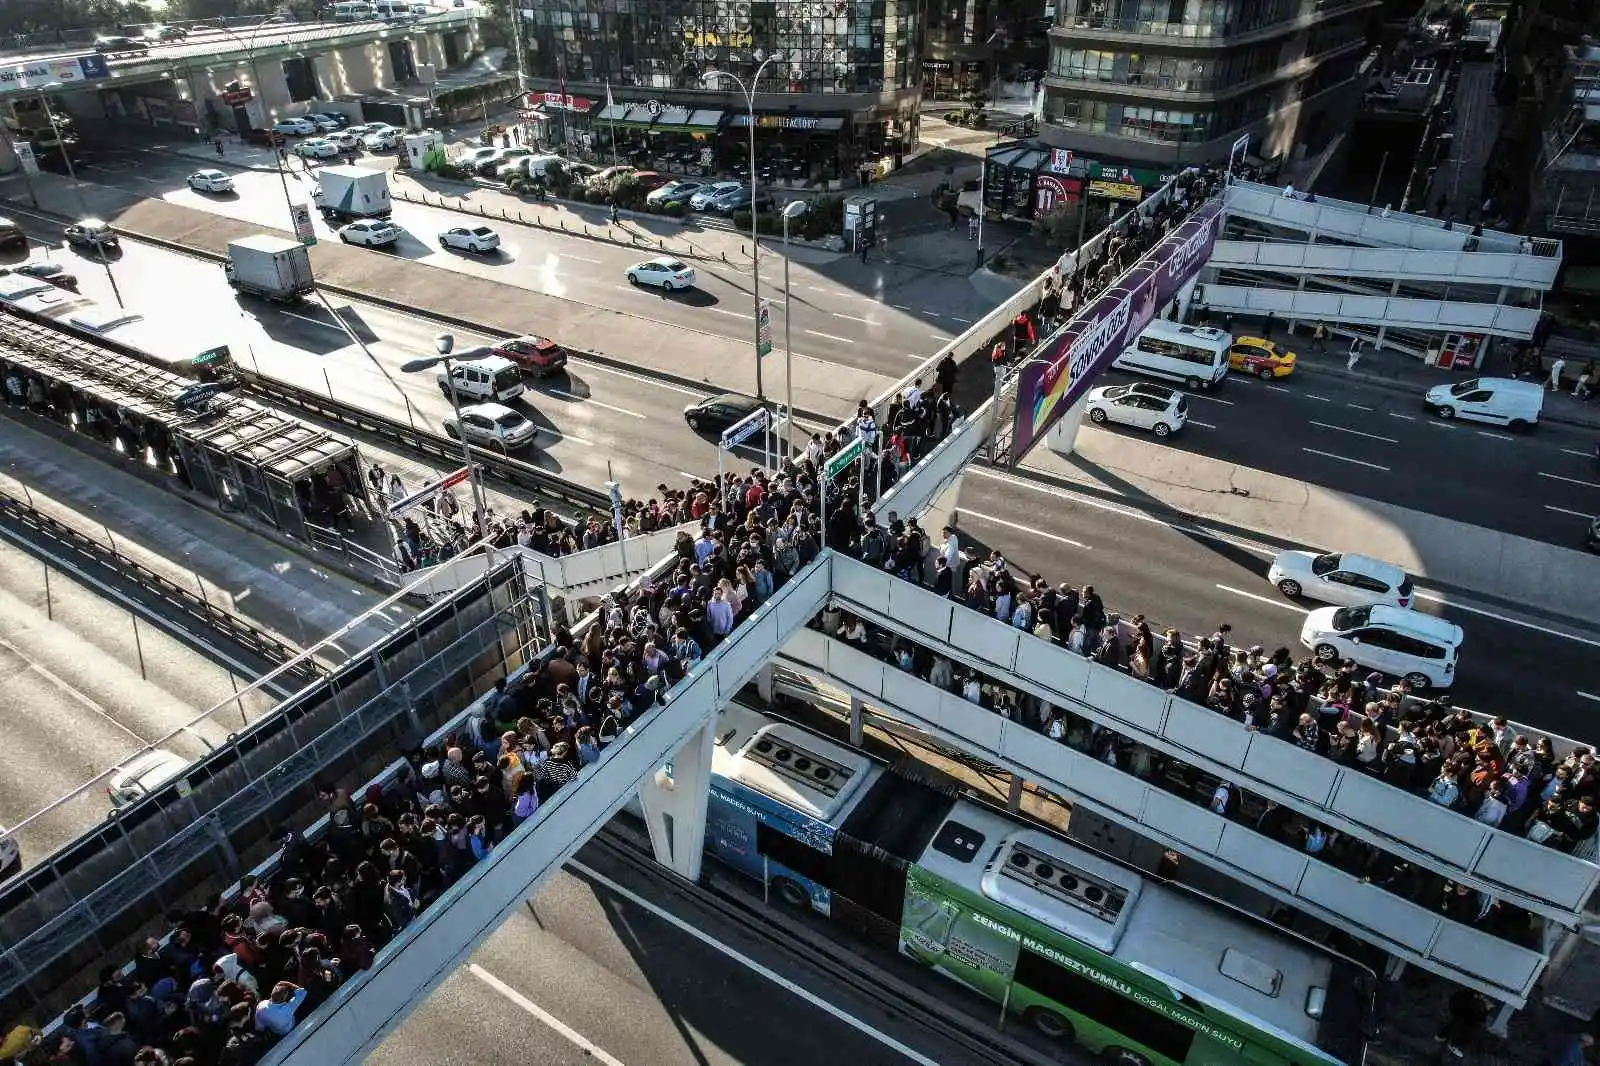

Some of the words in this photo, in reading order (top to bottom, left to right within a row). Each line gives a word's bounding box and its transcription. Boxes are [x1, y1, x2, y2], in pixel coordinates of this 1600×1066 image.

[1070, 328, 1106, 379] SONRA
[972, 912, 1022, 942] ZENGİN
[1023, 937, 1131, 995] MAGNEZYUMLU
[1171, 1010, 1210, 1033] MADEN
[1210, 1029, 1242, 1049] SUYU
